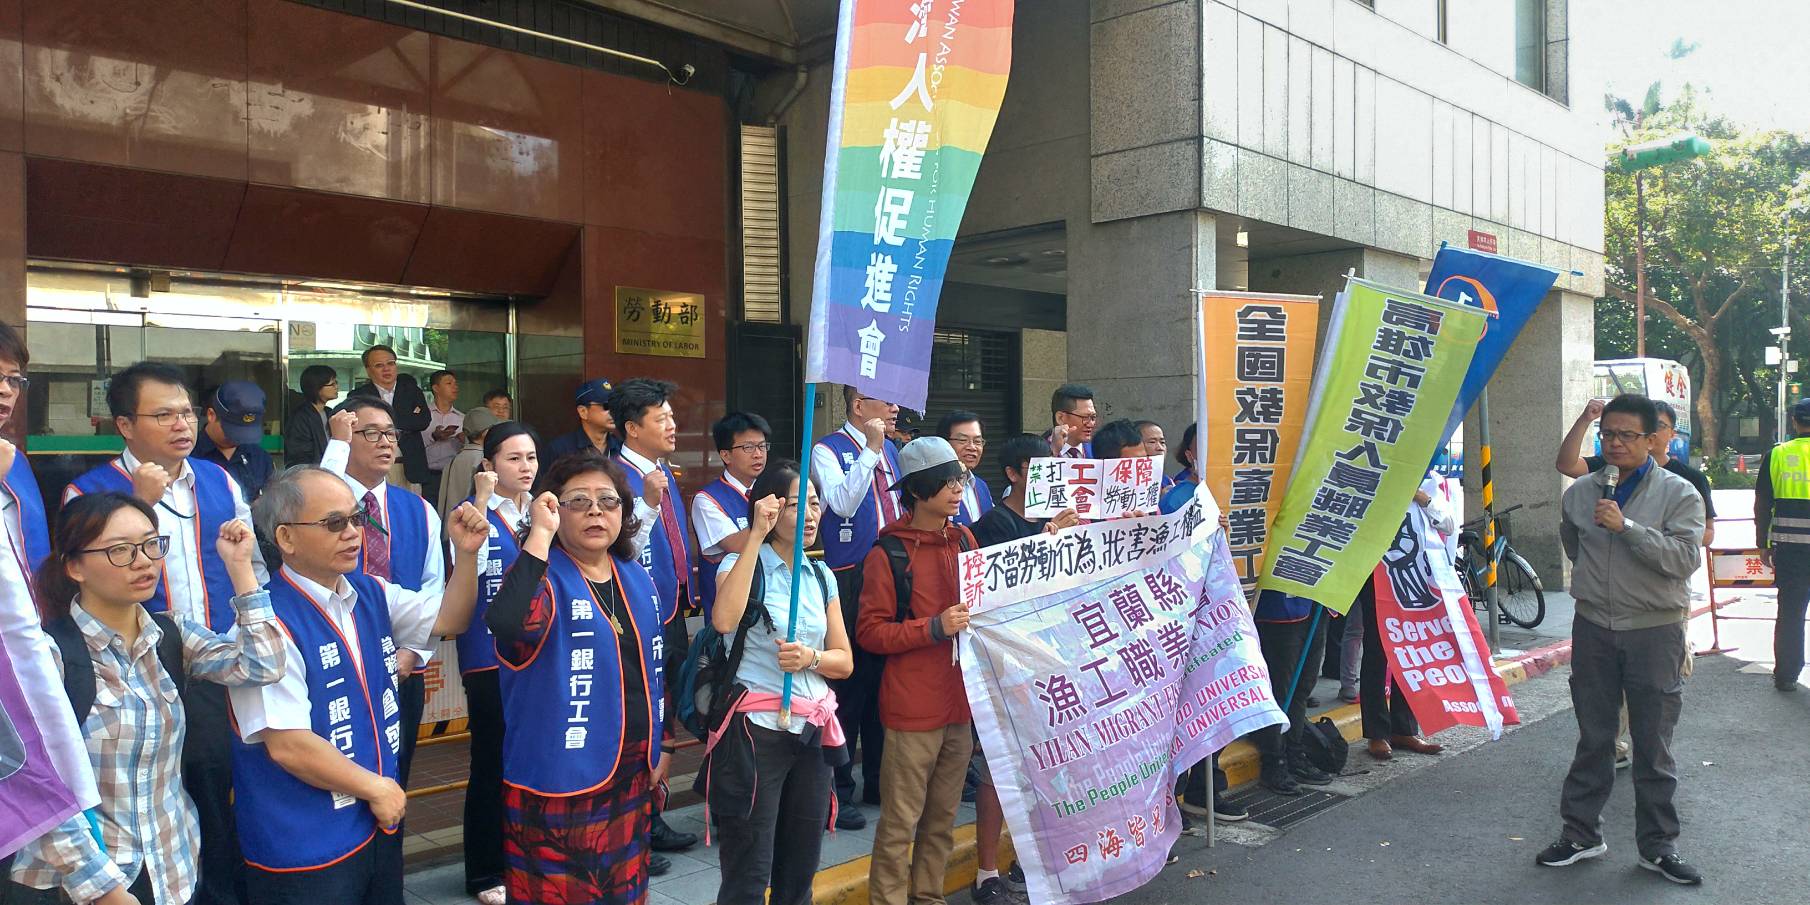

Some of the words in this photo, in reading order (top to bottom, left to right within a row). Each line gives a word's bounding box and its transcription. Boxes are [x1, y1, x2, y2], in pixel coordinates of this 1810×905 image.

[913, 199, 936, 271] HUMAN
[623, 296, 698, 327] 勞動部
[898, 274, 923, 333] RIGHTS
[622, 338, 660, 348] MINISTRY
[662, 340, 673, 349] OF
[675, 341, 699, 351] LABOR
[1025, 464, 1046, 508] 禁止
[1045, 461, 1067, 510] 打壓
[1069, 463, 1098, 514] 工會
[1104, 482, 1159, 514] 勞動三權
[1110, 459, 1153, 487] 保障
[962, 551, 985, 609] 控訴
[1072, 568, 1189, 650] 宜蘭縣
[1385, 616, 1455, 643] Serve
[564, 598, 595, 749] 第一銀行工會
[1393, 640, 1455, 669] the
[1195, 664, 1267, 707] UNIVERSA
[319, 641, 357, 810] 第一銀行
[1029, 728, 1093, 770] YILAN
[1092, 692, 1165, 749] MIGRANT
[1186, 685, 1269, 739] UNIVERSAL
[1052, 800, 1086, 818] The
[1087, 773, 1140, 806] People
[1138, 751, 1170, 780] Unite
